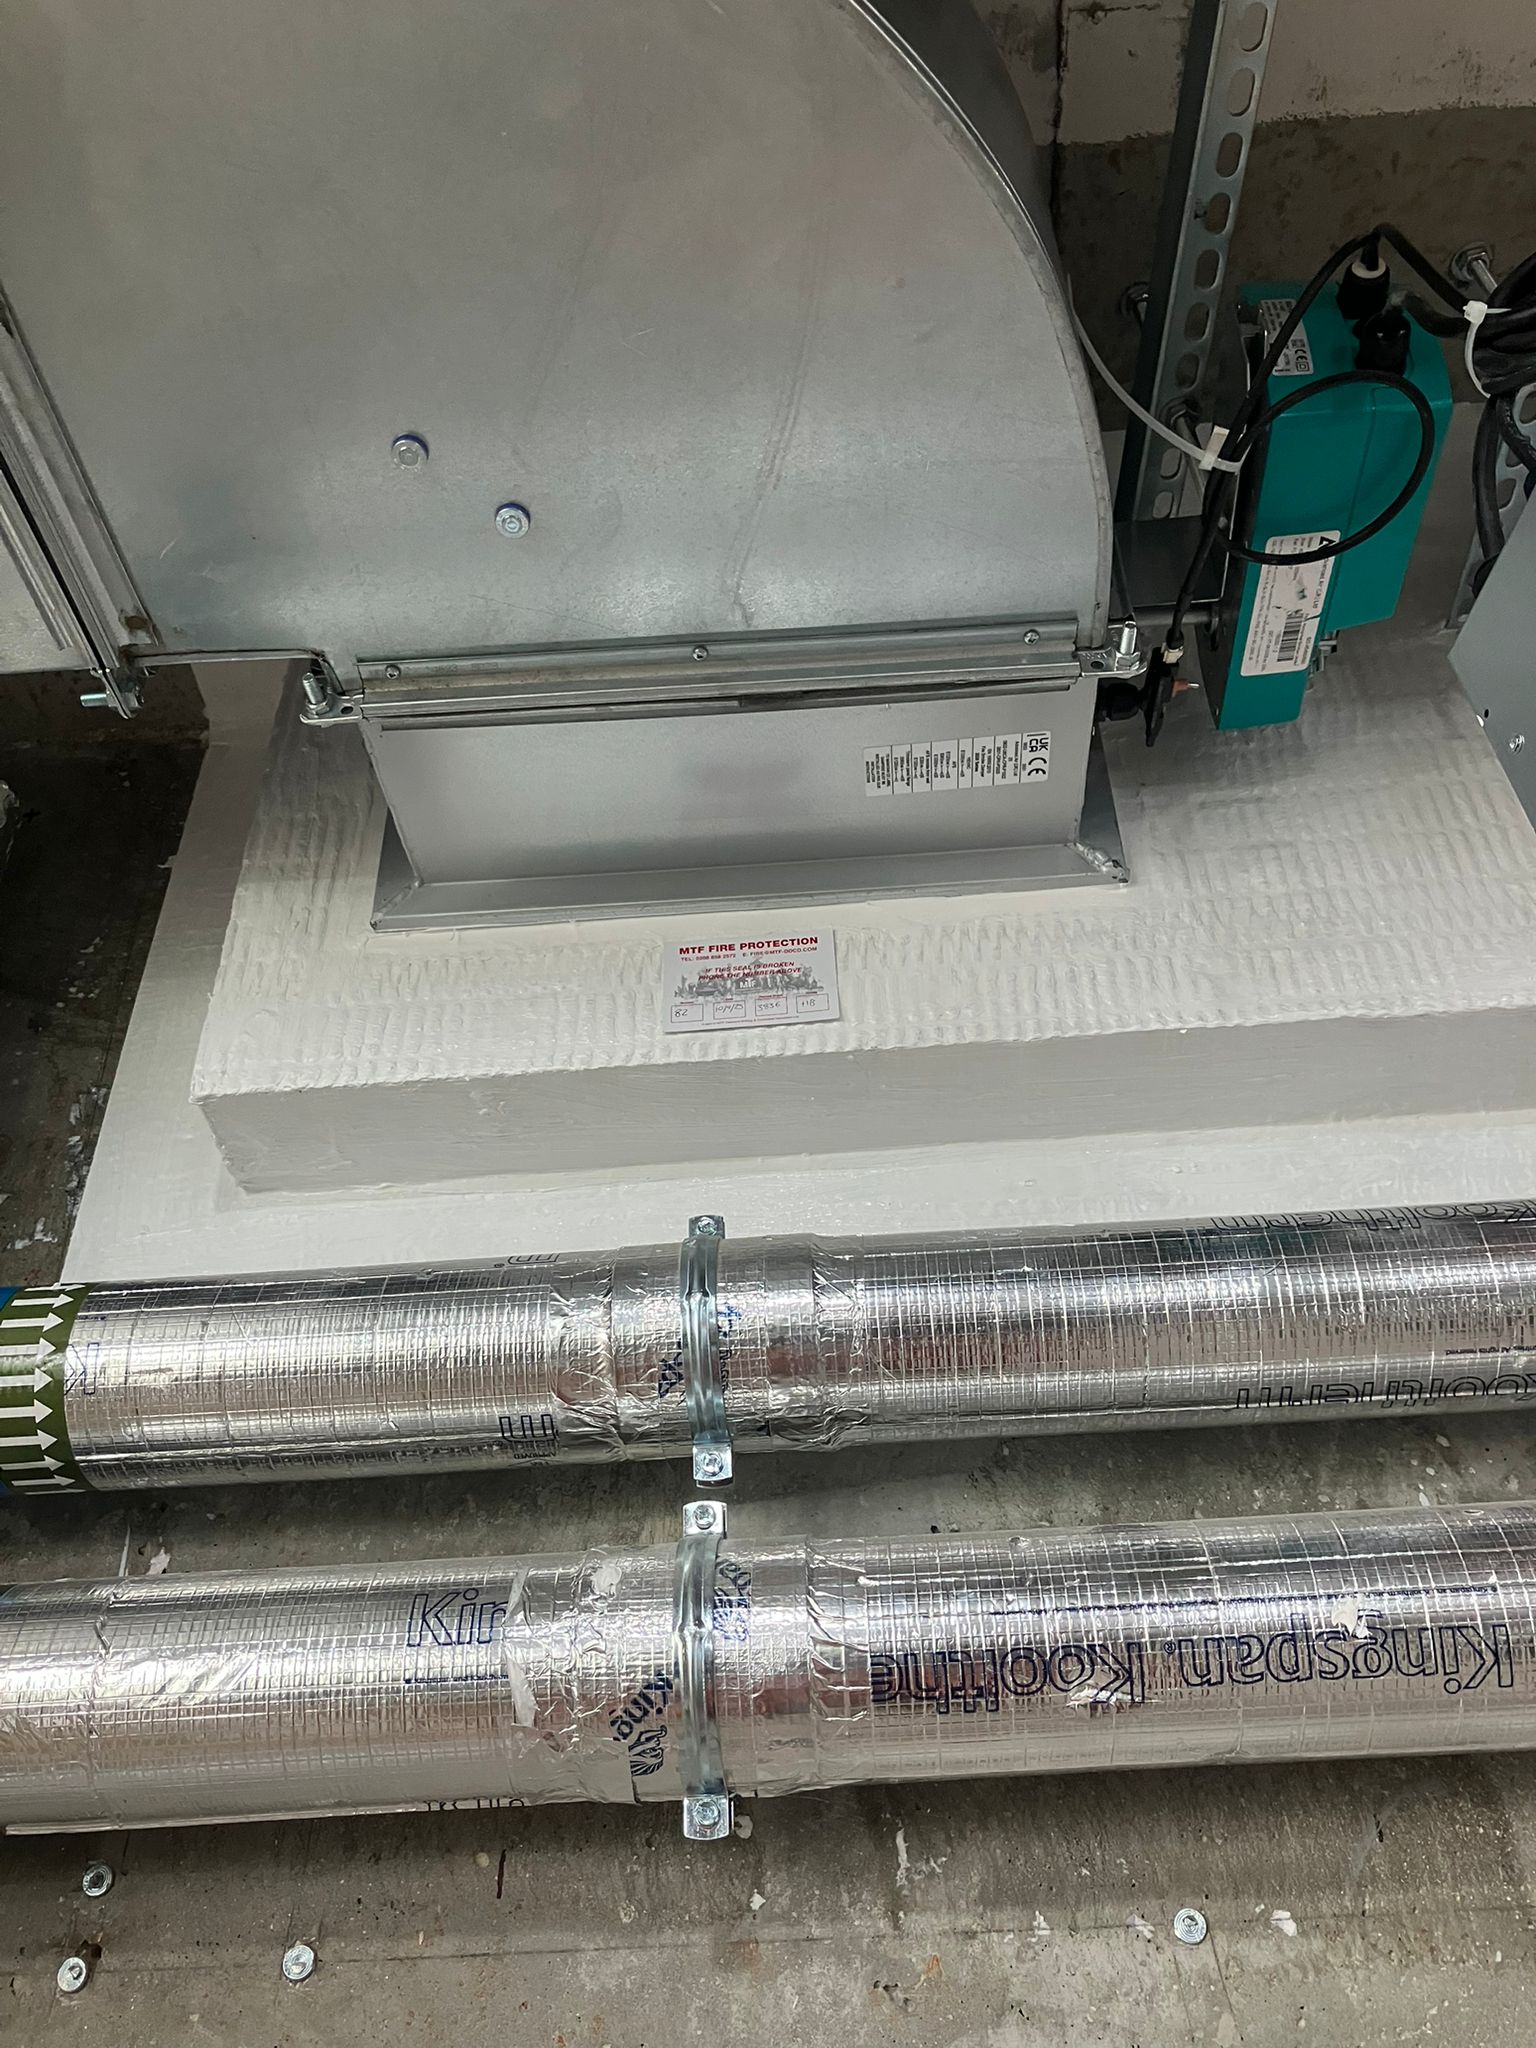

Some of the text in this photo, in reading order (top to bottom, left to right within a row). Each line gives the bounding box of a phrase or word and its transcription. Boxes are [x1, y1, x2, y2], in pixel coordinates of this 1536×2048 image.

[679, 936, 818, 955] MTF FIRE PROTECTION
